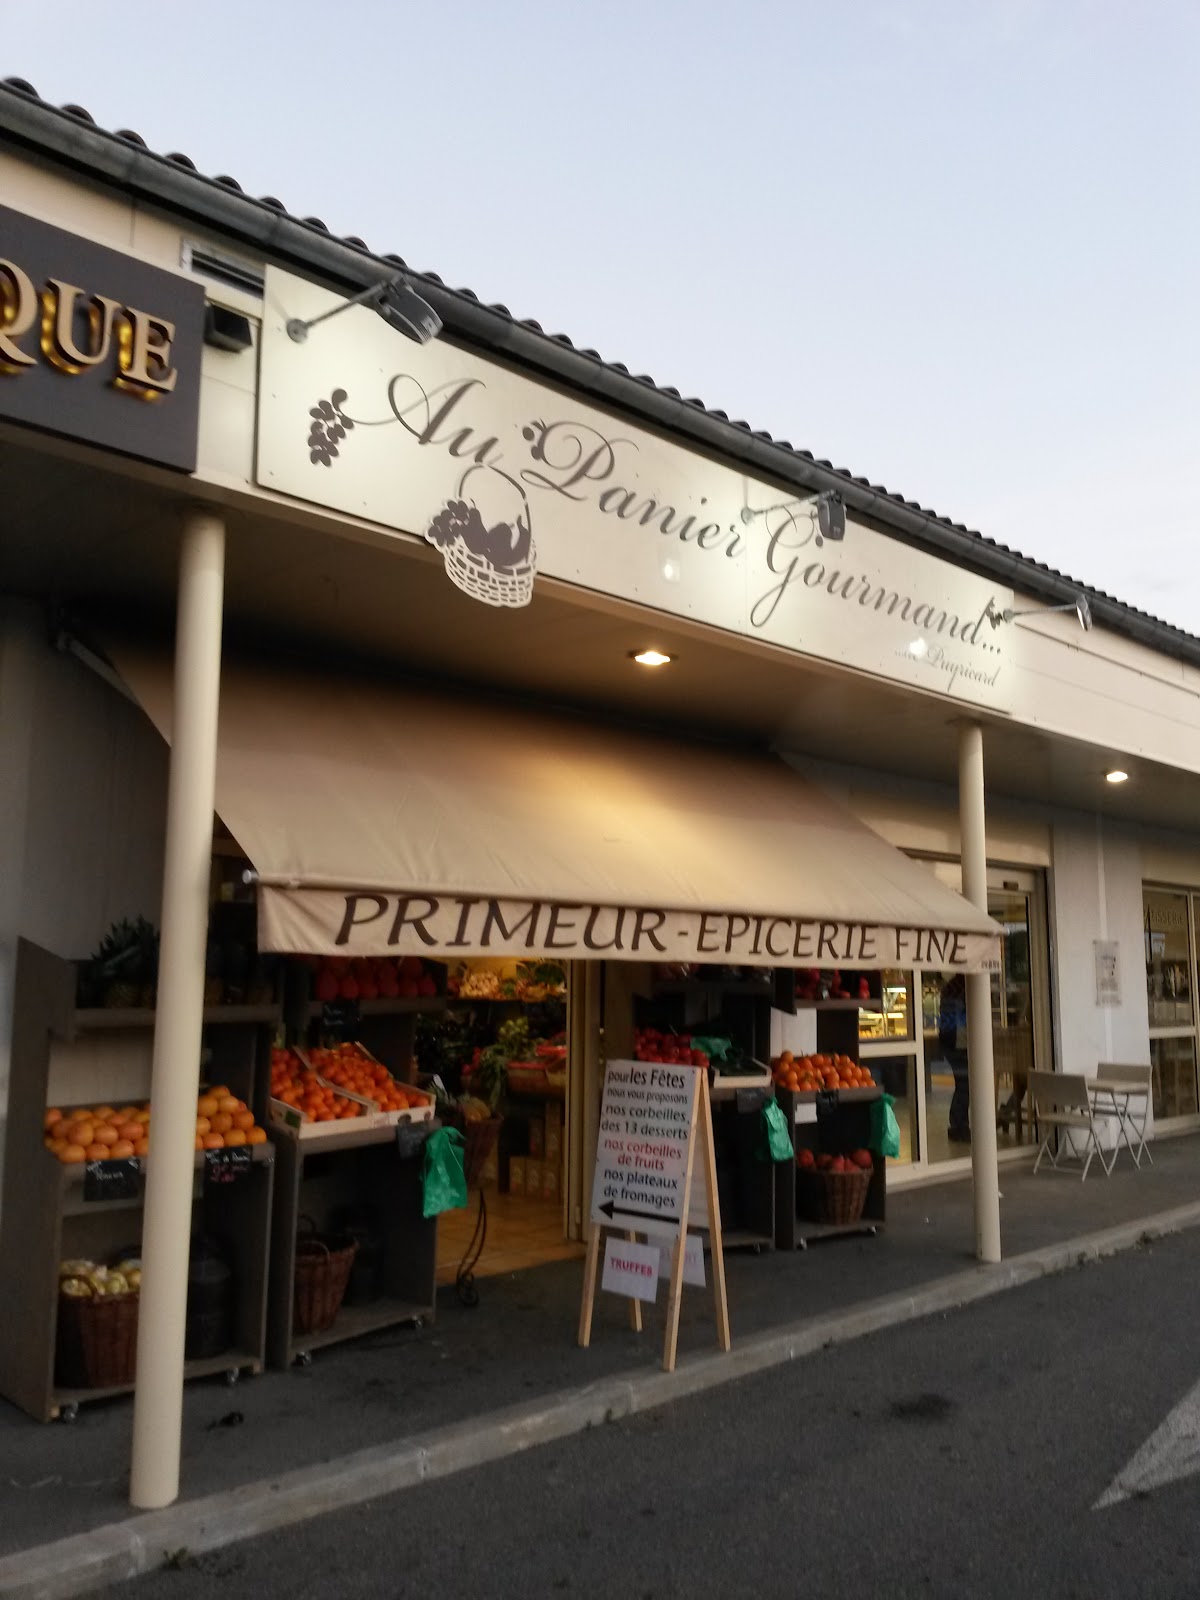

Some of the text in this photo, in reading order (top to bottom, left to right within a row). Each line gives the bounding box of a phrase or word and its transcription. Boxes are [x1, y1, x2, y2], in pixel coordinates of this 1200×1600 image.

[386, 373, 503, 464] Au
[520, 419, 747, 560] Panier
[895, 926, 968, 966] FINE
[607, 1066, 686, 1090] pour les Fêtes
[607, 1086, 688, 1105] nous vous proposons
[605, 1103, 626, 1117] nos
[601, 1119, 688, 1141] des 13 desserts
[604, 1138, 682, 1160] nos corbeilles
[617, 1153, 665, 1172] de fruits
[604, 1168, 678, 1190] nos plateaux
[604, 1184, 676, 1210] de fromages
